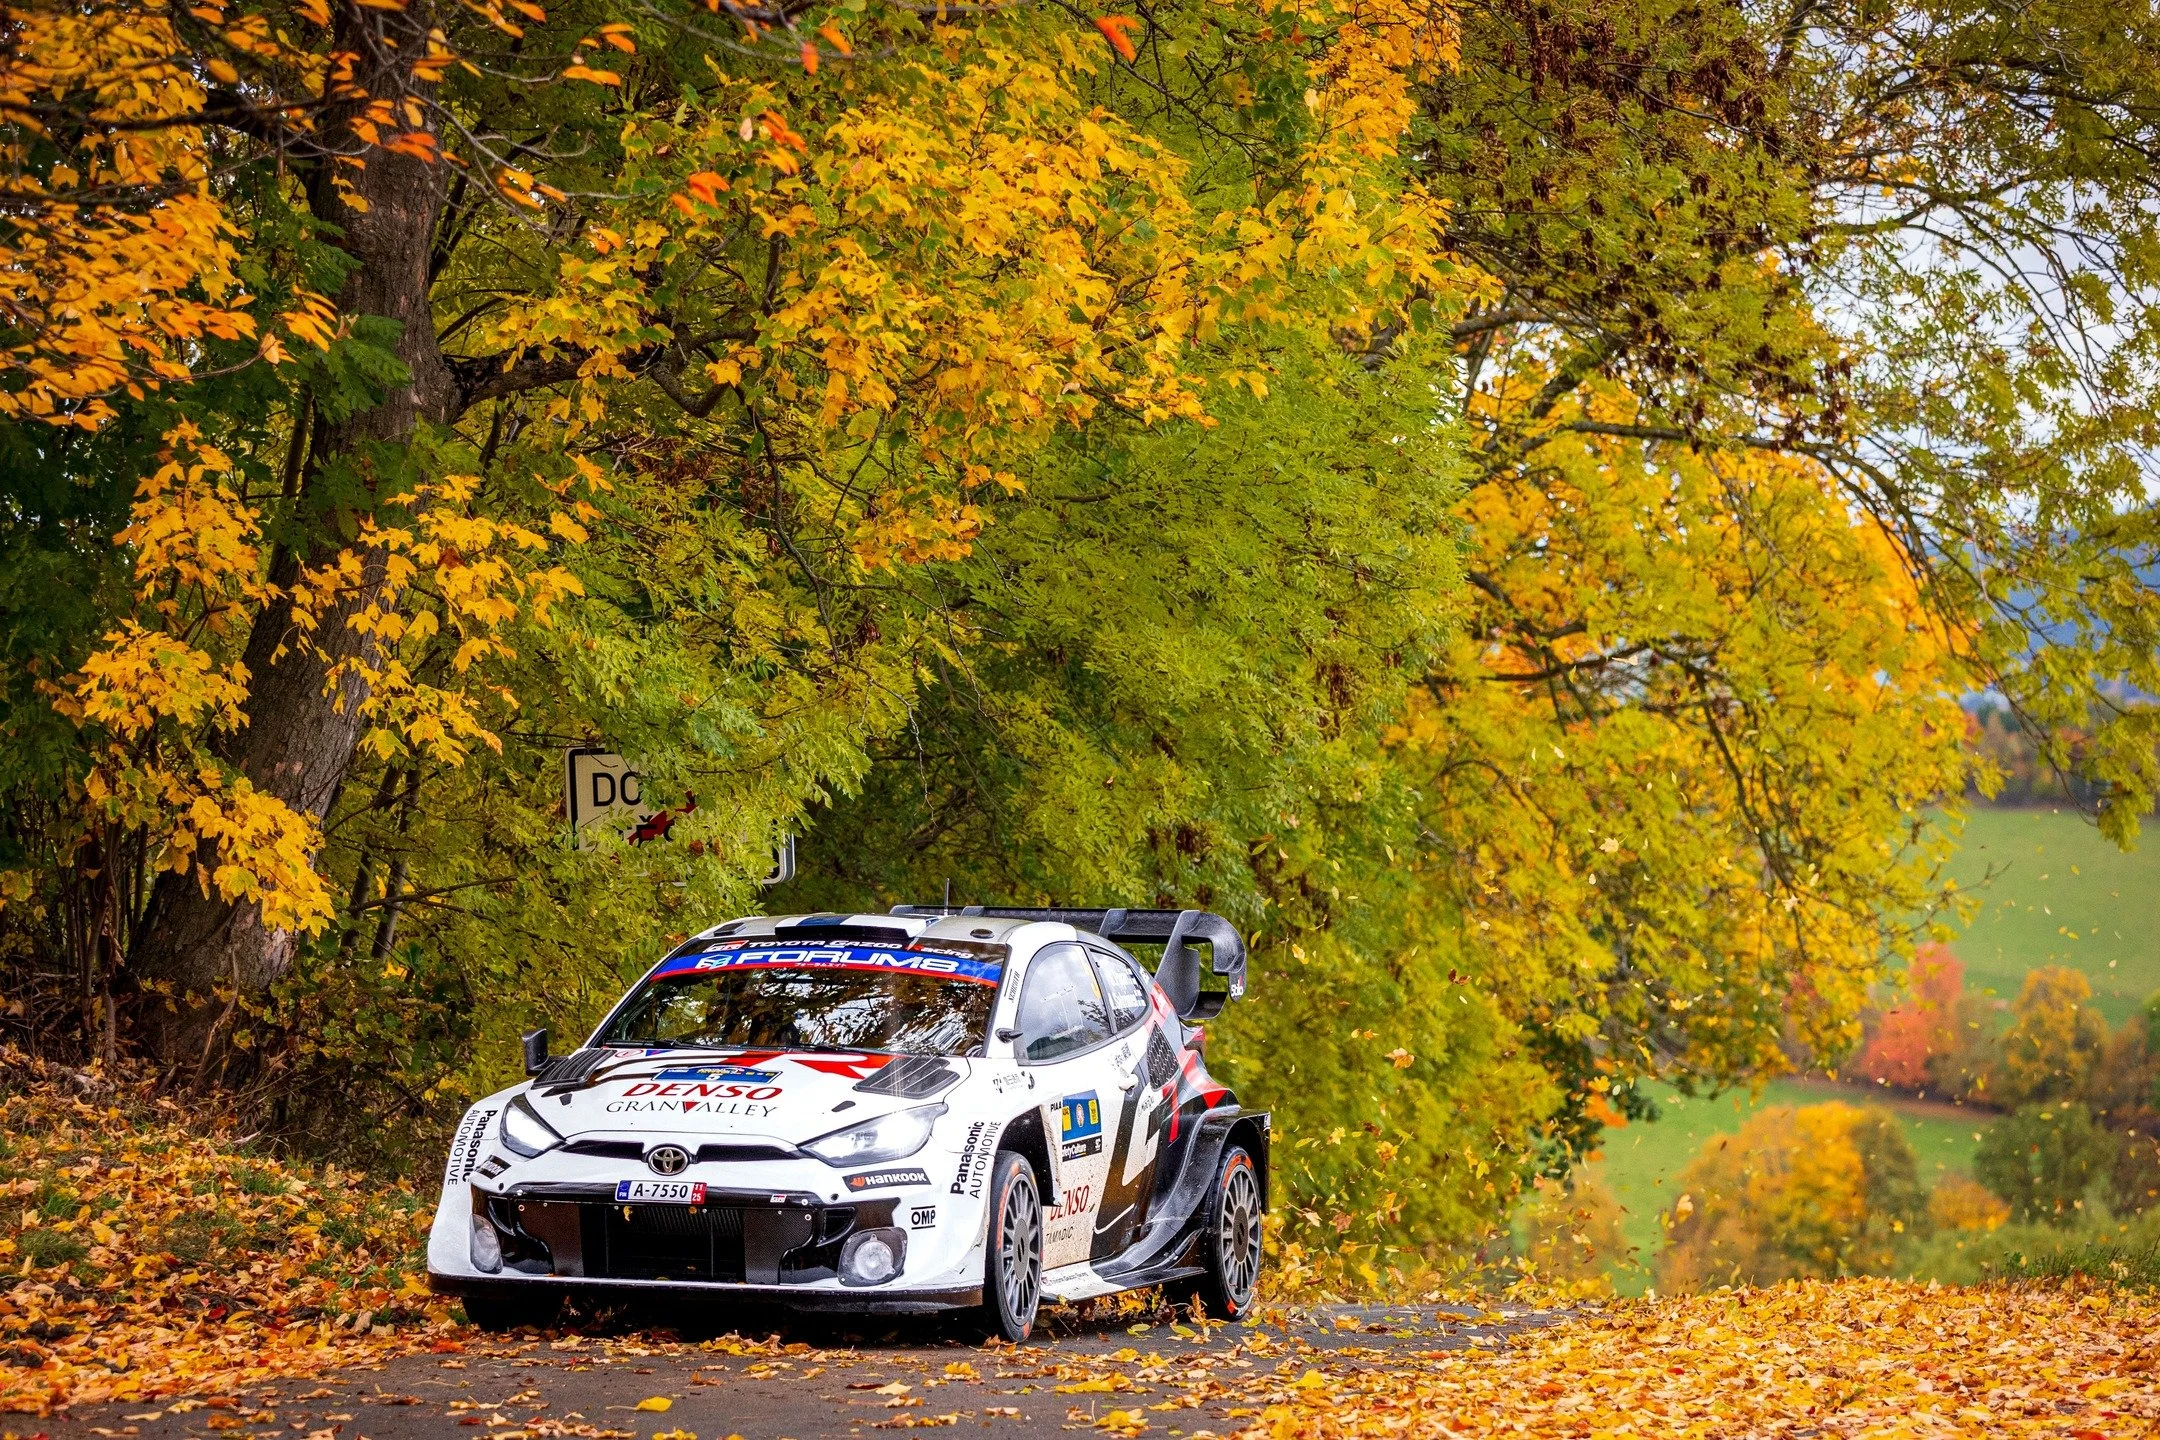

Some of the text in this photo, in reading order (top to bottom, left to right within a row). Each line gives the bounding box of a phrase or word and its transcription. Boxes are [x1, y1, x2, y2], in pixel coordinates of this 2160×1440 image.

[749, 940, 826, 949] TOYOTA
[826, 940, 903, 949] GAZOO
[735, 950, 959, 973] FORUM8
[622, 1083, 783, 1101] DENSO
[448, 1109, 480, 1186] AUTOMOTIVE
[462, 1109, 499, 1183] Panasonic
[950, 1121, 985, 1195] Panasonic
[969, 1120, 1002, 1199] AUTOMOTIVE
[633, 1183, 689, 1199] A-7550
[692, 1193, 702, 1201] 25
[911, 1209, 936, 1226] OMP
